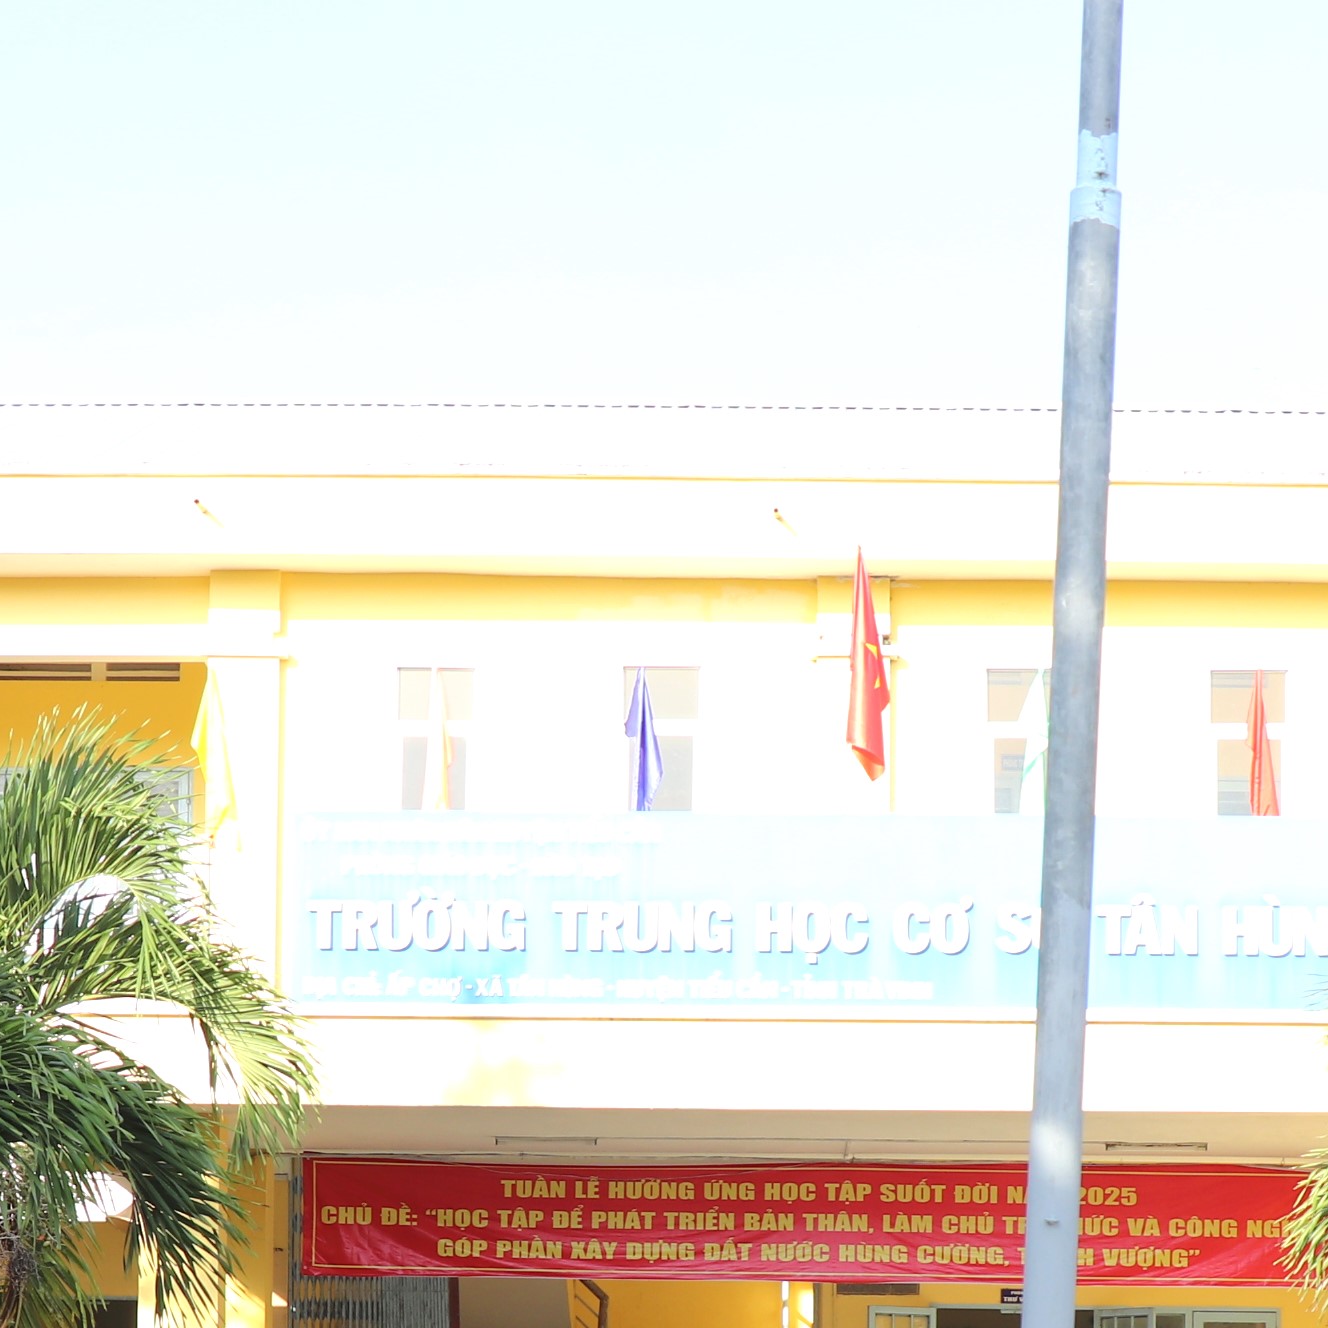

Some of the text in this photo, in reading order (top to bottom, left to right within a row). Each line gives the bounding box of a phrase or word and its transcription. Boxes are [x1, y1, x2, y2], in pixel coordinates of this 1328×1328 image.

[306, 886, 529, 954] TRƯỜNG
[551, 897, 736, 954] TRUNG
[753, 897, 871, 965] HỌC
[891, 895, 975, 956] CƠ
[994, 896, 1043, 956] S
[1097, 893, 1199, 958] TÂN
[501, 1174, 566, 1198] TUẦN
[575, 1175, 599, 1199] LỄ
[704, 1178, 755, 1200] ỨNG
[764, 1181, 816, 1205] HỌC
[824, 1180, 872, 1205] TẬP
[880, 1178, 946, 1203] SUỐT
[954, 1182, 998, 1204] ĐỜI
[1079, 1187, 1137, 1206] 2025
[322, 1202, 372, 1226] CHỦ
[381, 1202, 418, 1226] ĐỀ:
[497, 1206, 544, 1232] TẬP
[552, 1204, 584, 1229] ĐỂ
[591, 1208, 656, 1230] PHÁT
[663, 1205, 736, 1232] TRIỂN
[743, 1208, 795, 1232] BẢN
[802, 1210, 875, 1234] THÂN,
[882, 1211, 933, 1234] LÀM
[941, 1211, 994, 1235] CHỦ
[1127, 1216, 1161, 1237] VÀ
[1169, 1213, 1238, 1238] CÔNG
[437, 1236, 488, 1258] GÓP
[496, 1234, 562, 1259] PHẦN
[570, 1238, 617, 1260] XÂY
[625, 1239, 695, 1264] DỰNG
[703, 1236, 752, 1261] ĐẤT
[761, 1239, 830, 1262] NƯỚC
[839, 1241, 909, 1263] HÙNG
[917, 1243, 1009, 1266] CƯỜNG,
